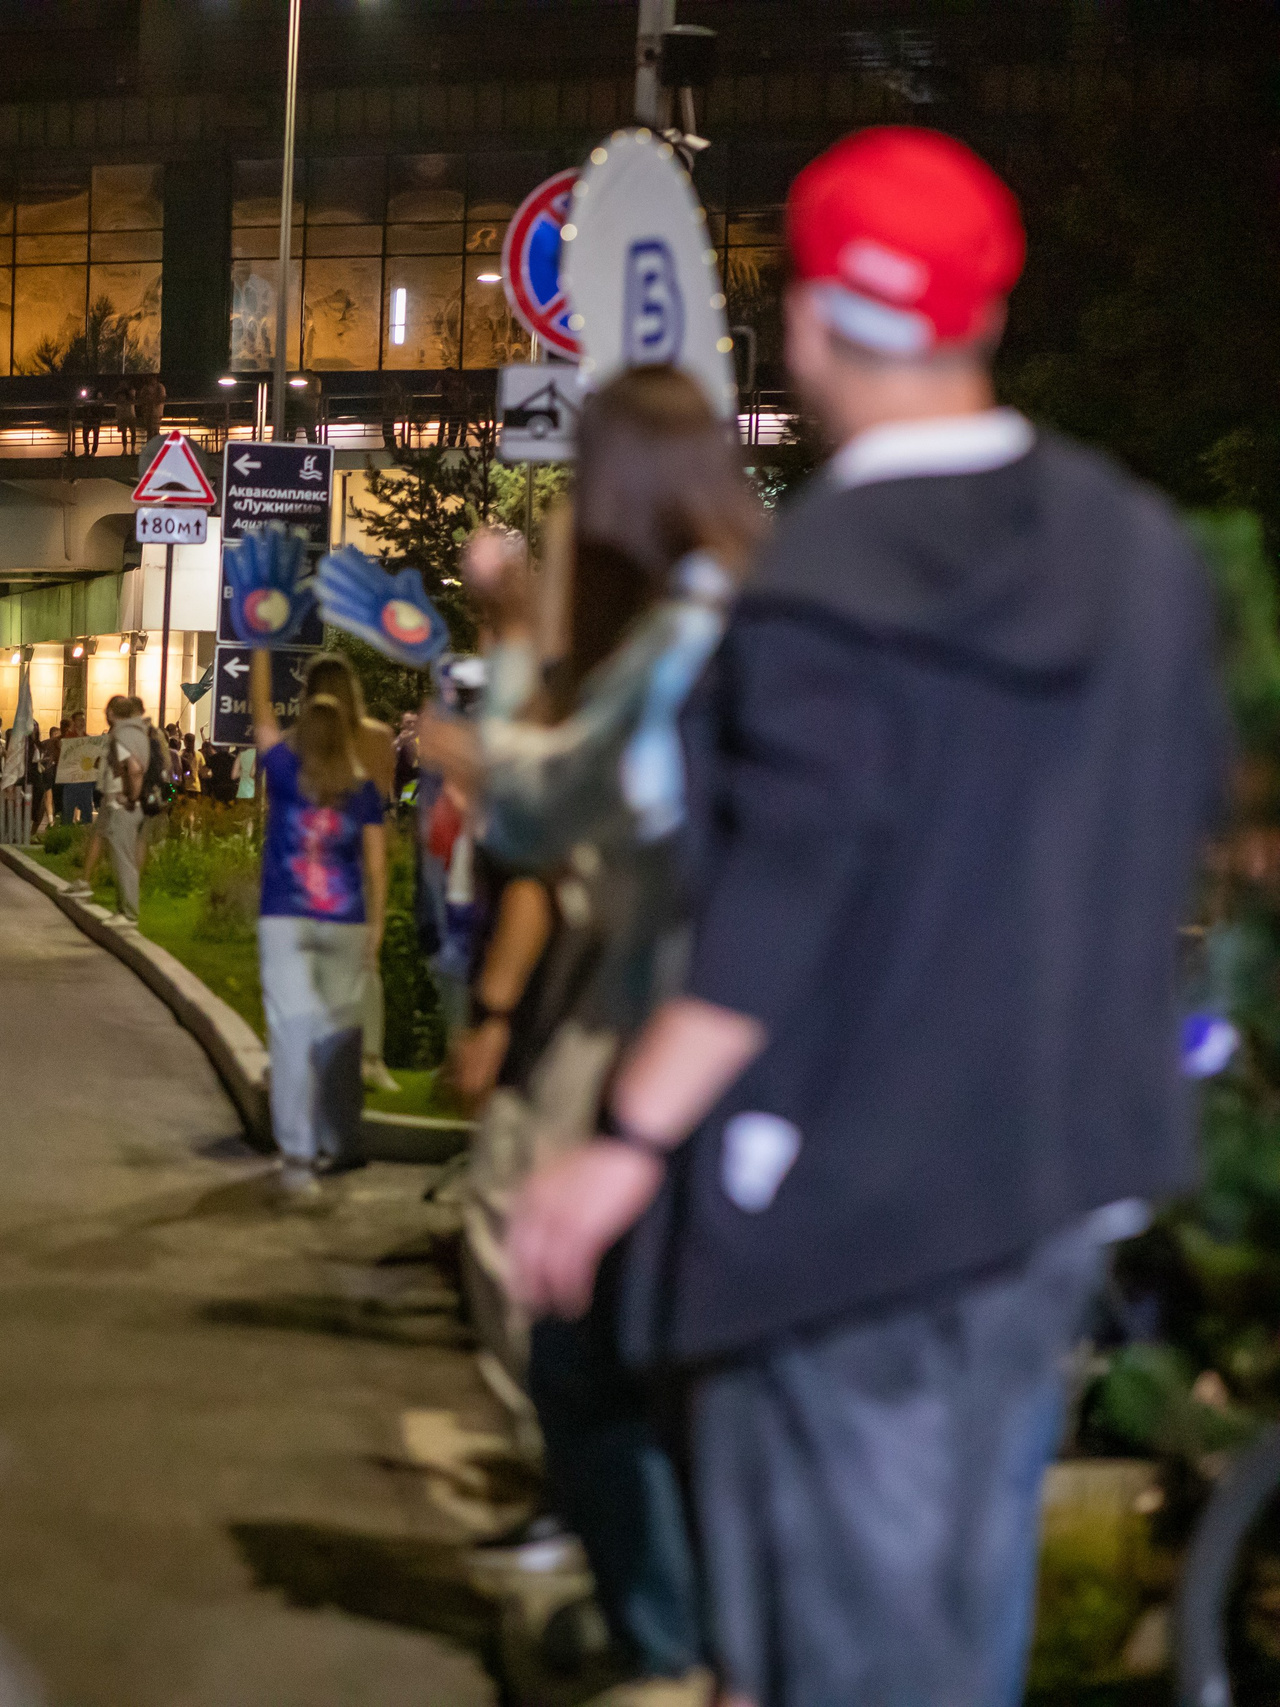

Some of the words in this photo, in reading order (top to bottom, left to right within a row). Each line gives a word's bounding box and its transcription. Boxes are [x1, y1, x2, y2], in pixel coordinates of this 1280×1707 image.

[228, 485, 328, 501] Аквакомплекс
[232, 499, 322, 515] «Лужники»
[220, 695, 300, 716] Зиай
